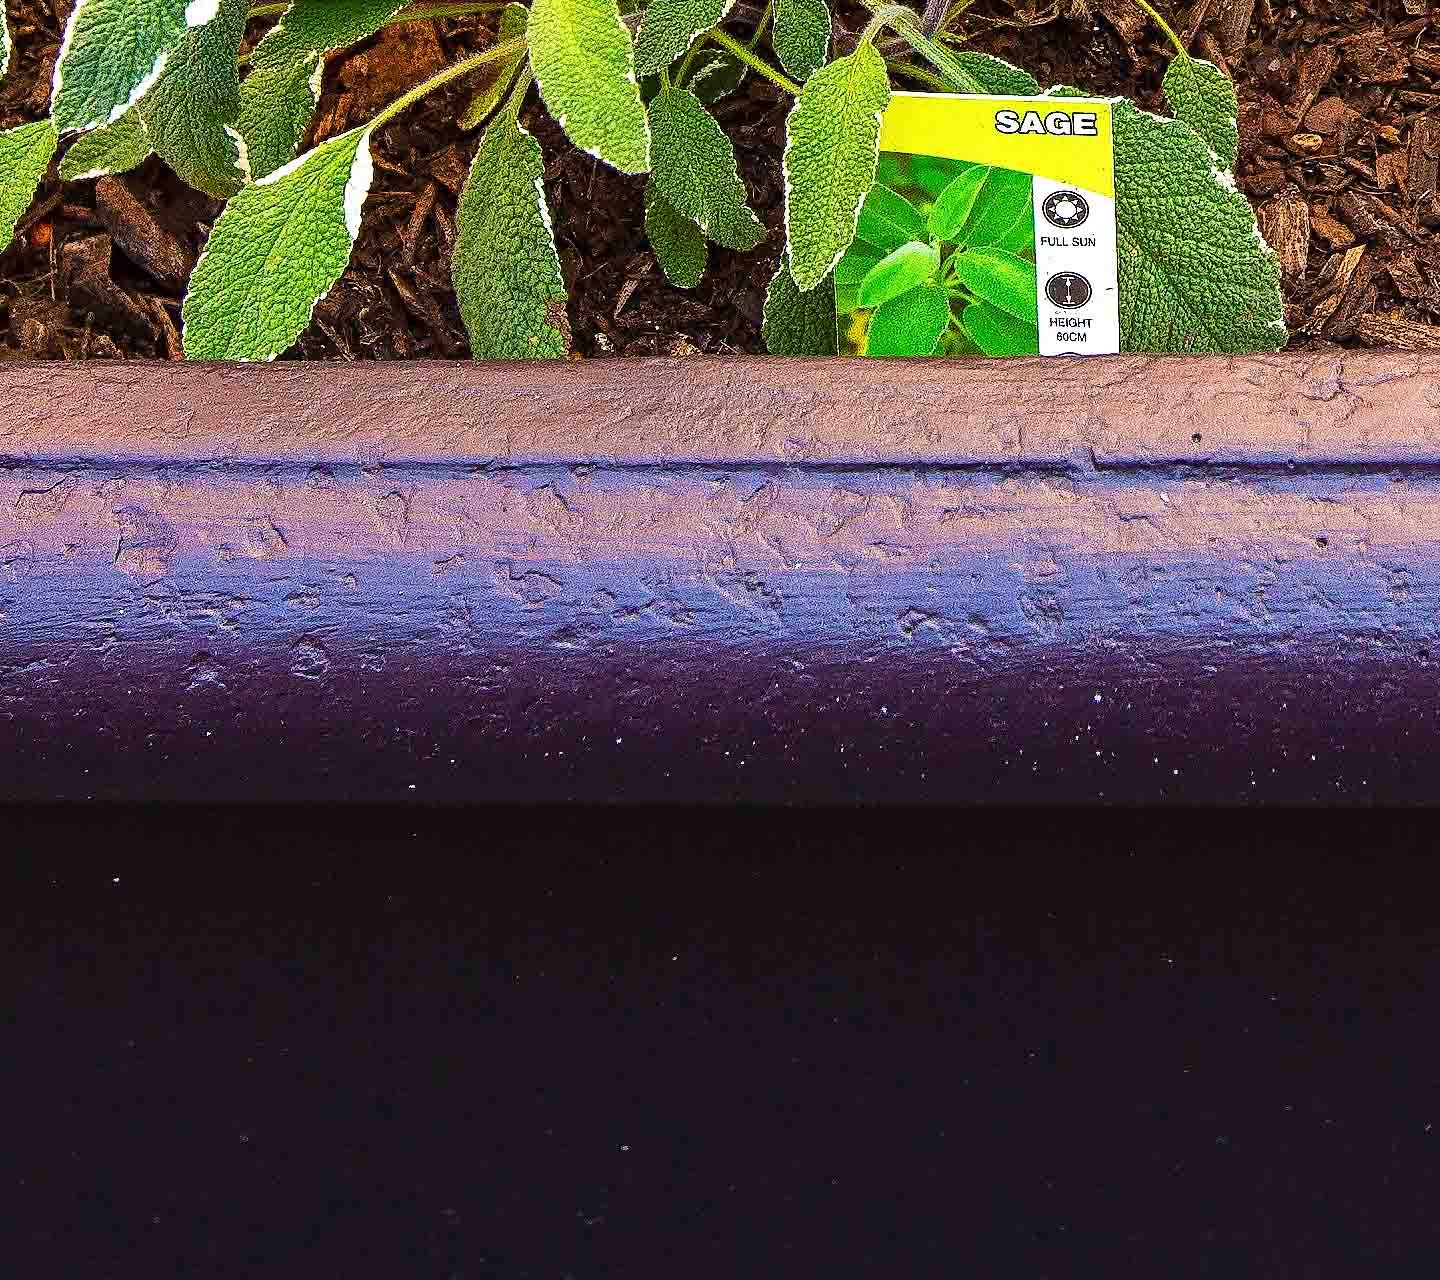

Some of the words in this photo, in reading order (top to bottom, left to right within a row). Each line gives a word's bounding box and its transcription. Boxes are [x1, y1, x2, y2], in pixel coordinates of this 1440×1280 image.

[995, 110, 1098, 136] SAGE
[1040, 236, 1069, 247] FULL
[1071, 237, 1096, 247] SUN
[1049, 317, 1093, 328] HEIGHT
[1056, 332, 1087, 342] 60CM
